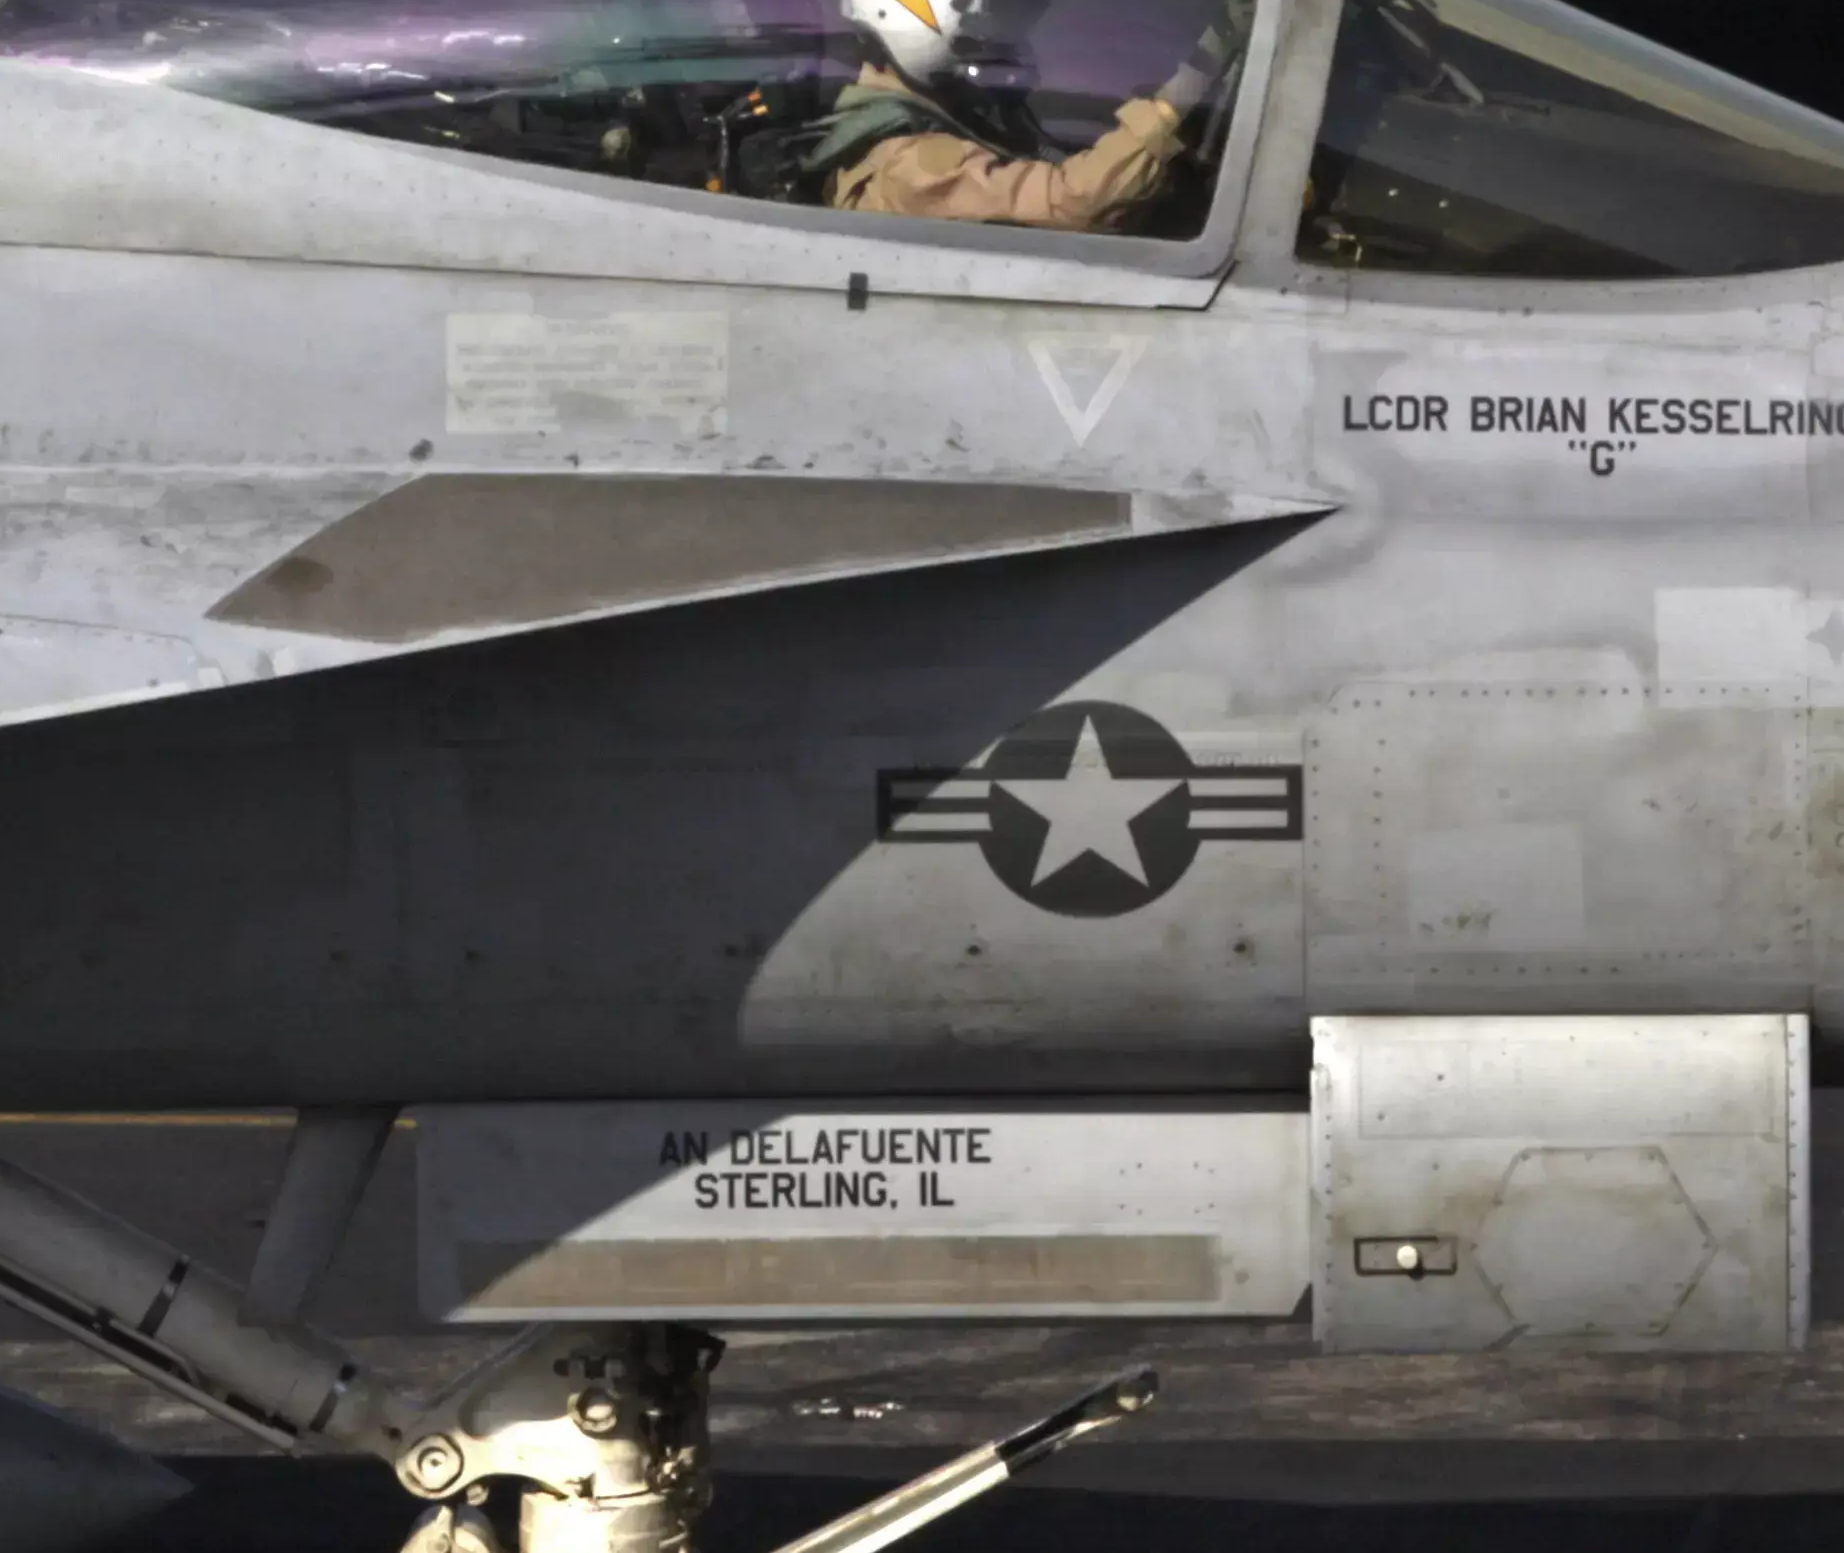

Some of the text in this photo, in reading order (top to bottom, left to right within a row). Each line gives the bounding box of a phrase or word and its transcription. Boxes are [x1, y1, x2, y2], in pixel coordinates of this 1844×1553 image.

[1342, 394, 1449, 432] LCDR
[1469, 395, 1587, 434] BRIAN
[1567, 440, 1637, 477] "G"
[658, 1128, 992, 1166] AN DELAFUENTE
[693, 1170, 955, 1210] STERLING, IL
